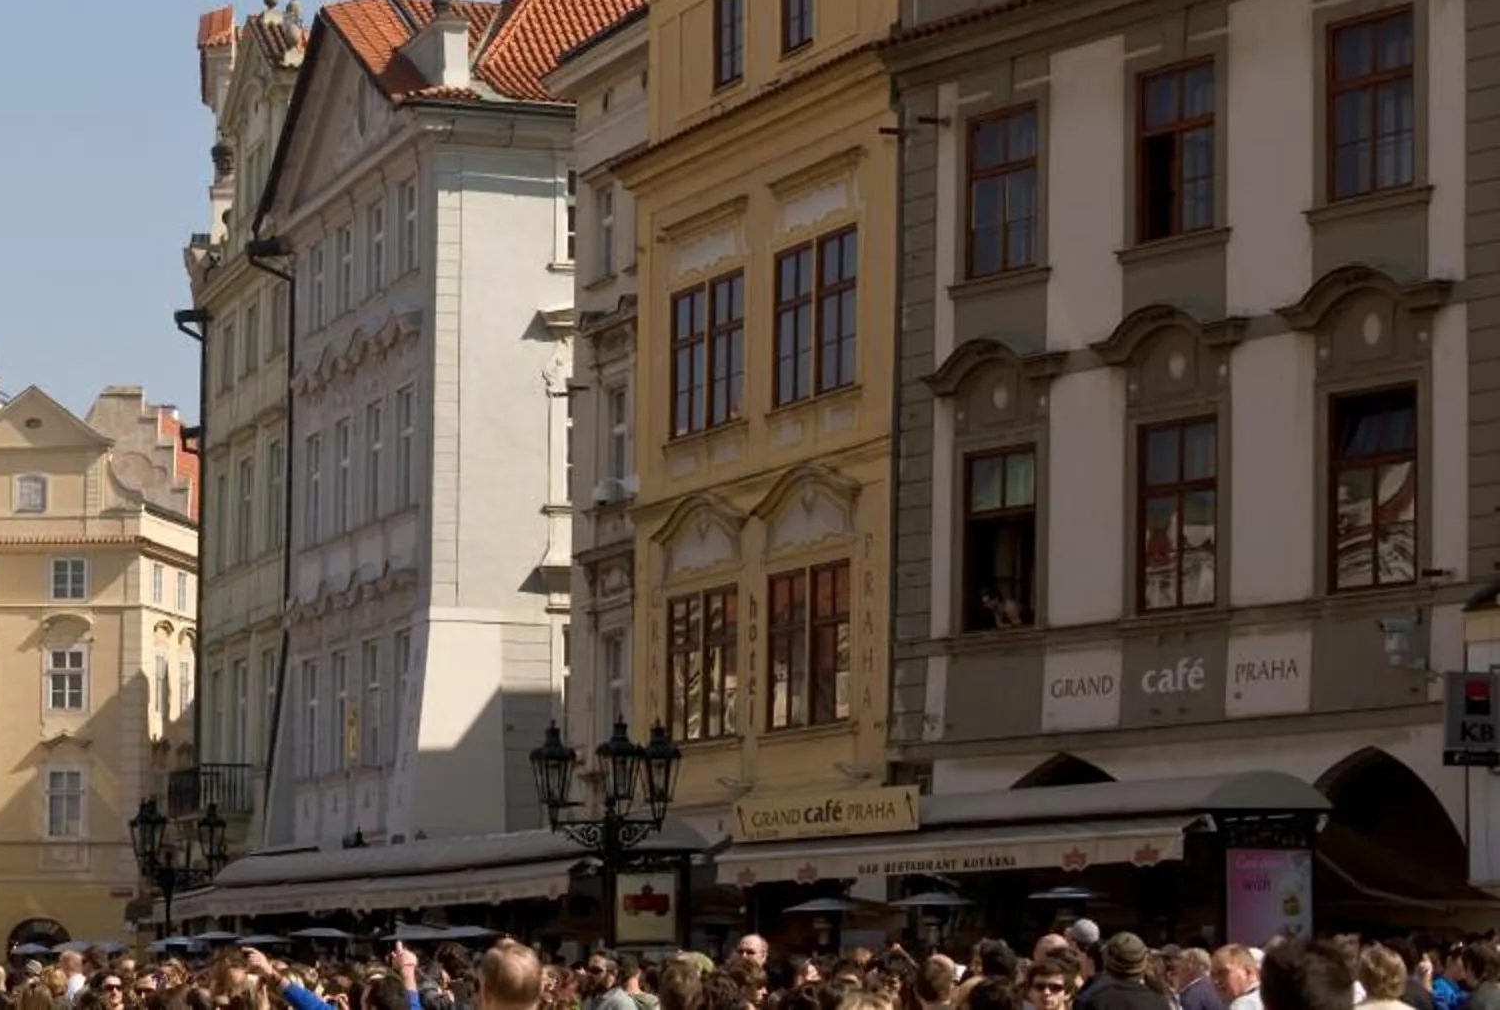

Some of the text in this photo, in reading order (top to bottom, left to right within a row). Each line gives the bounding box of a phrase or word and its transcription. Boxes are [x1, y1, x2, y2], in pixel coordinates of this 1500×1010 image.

[863, 533, 874, 709] PRAHA
[748, 594, 757, 727] hotel
[1051, 657, 1299, 699] GRAND café PRAHA
[1460, 720, 1495, 742] KB
[751, 799, 896, 828] GRAND café PRAHA
